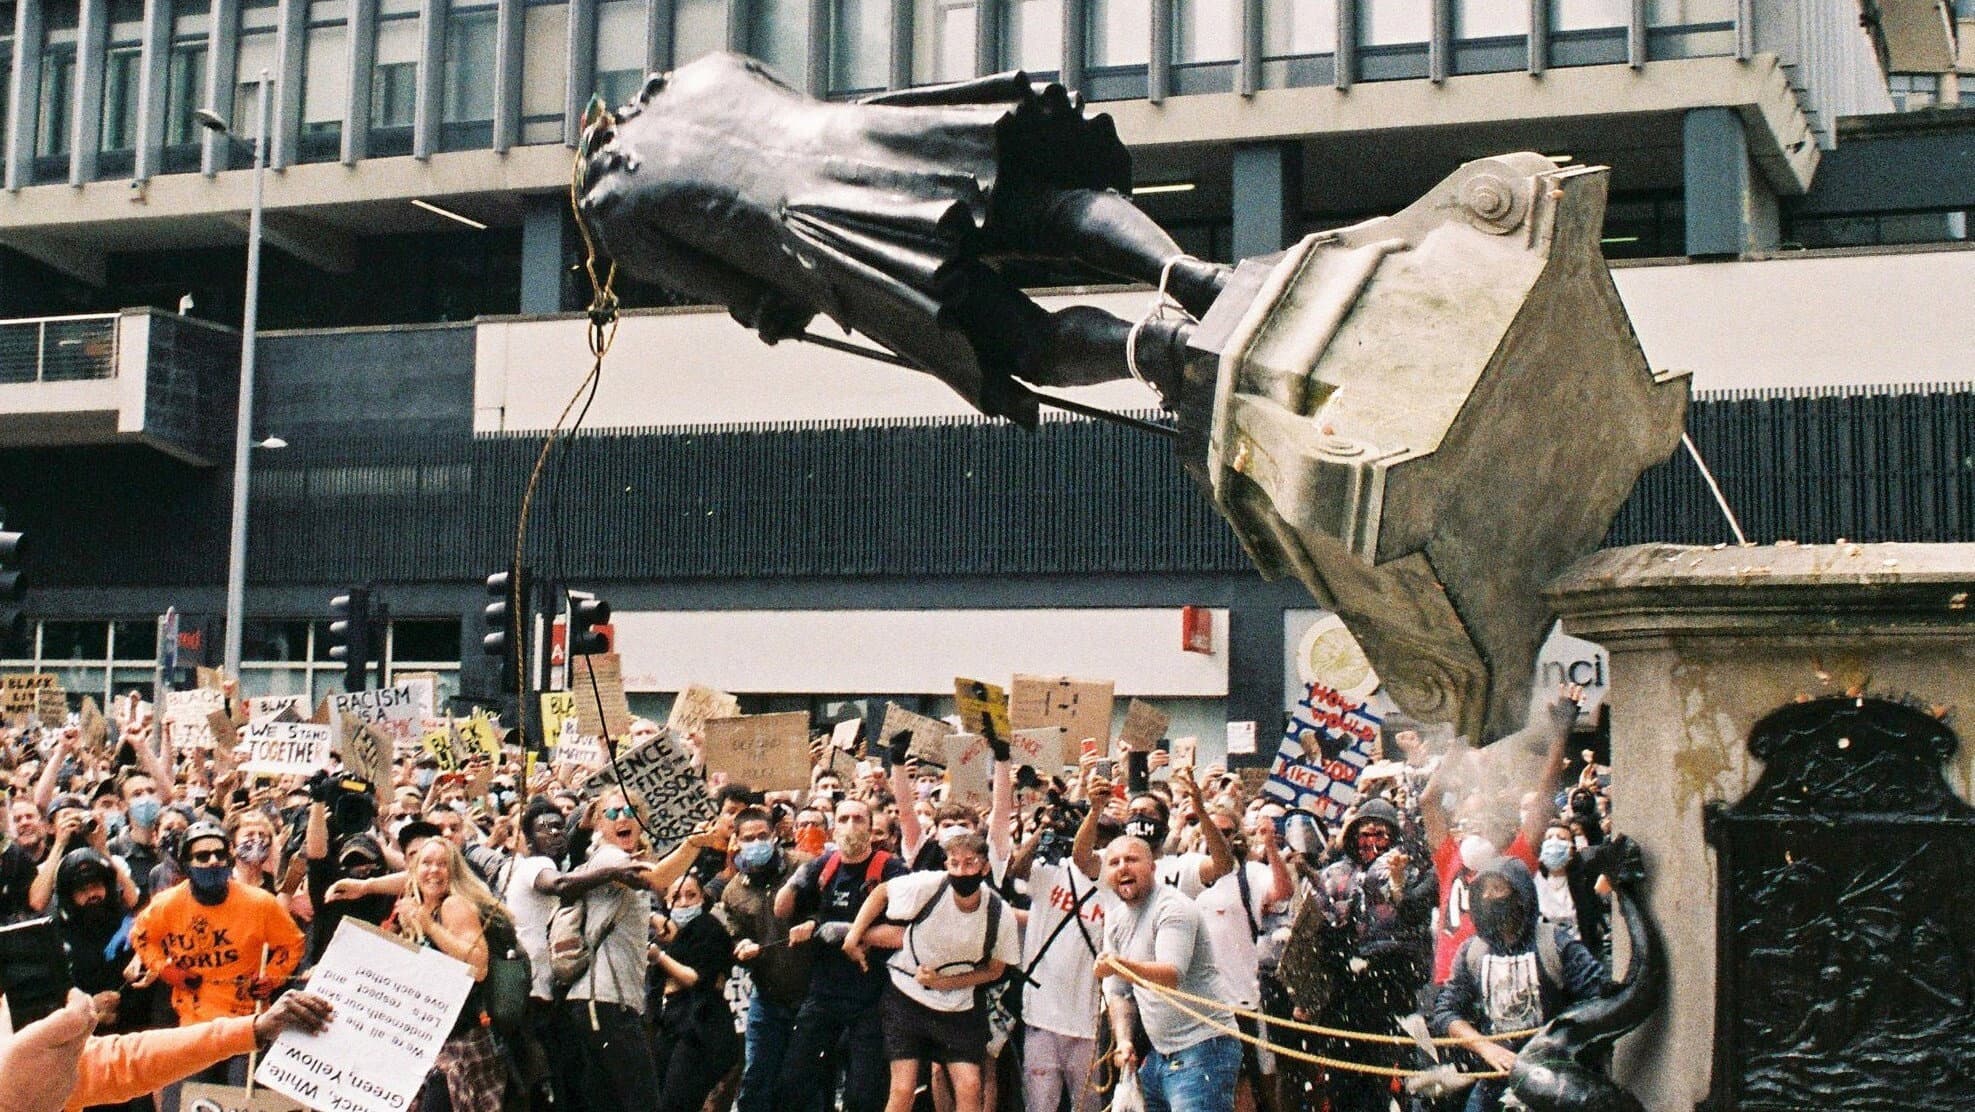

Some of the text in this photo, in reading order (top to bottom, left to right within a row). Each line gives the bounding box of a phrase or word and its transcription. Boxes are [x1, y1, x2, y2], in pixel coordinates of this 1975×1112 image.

[1543, 653, 1604, 689] nci
[336, 685, 410, 712] RACISM
[551, 697, 575, 715] BLA
[250, 723, 328, 740] WE STAND
[1312, 707, 1377, 742] WOULD
[249, 741, 322, 763] TOGETHER
[1277, 758, 1319, 789] LIKE
[645, 767, 702, 808] ESSOR
[323, 970, 442, 1028] Let's respect and
[393, 981, 421, 999] each
[343, 997, 364, 1012] our
[424, 995, 450, 1014] love
[345, 1016, 364, 1031] the
[366, 1007, 433, 1041] underneath
[369, 1027, 385, 1039] all
[267, 1060, 320, 1100] White,
[349, 1071, 405, 1109] Green,
